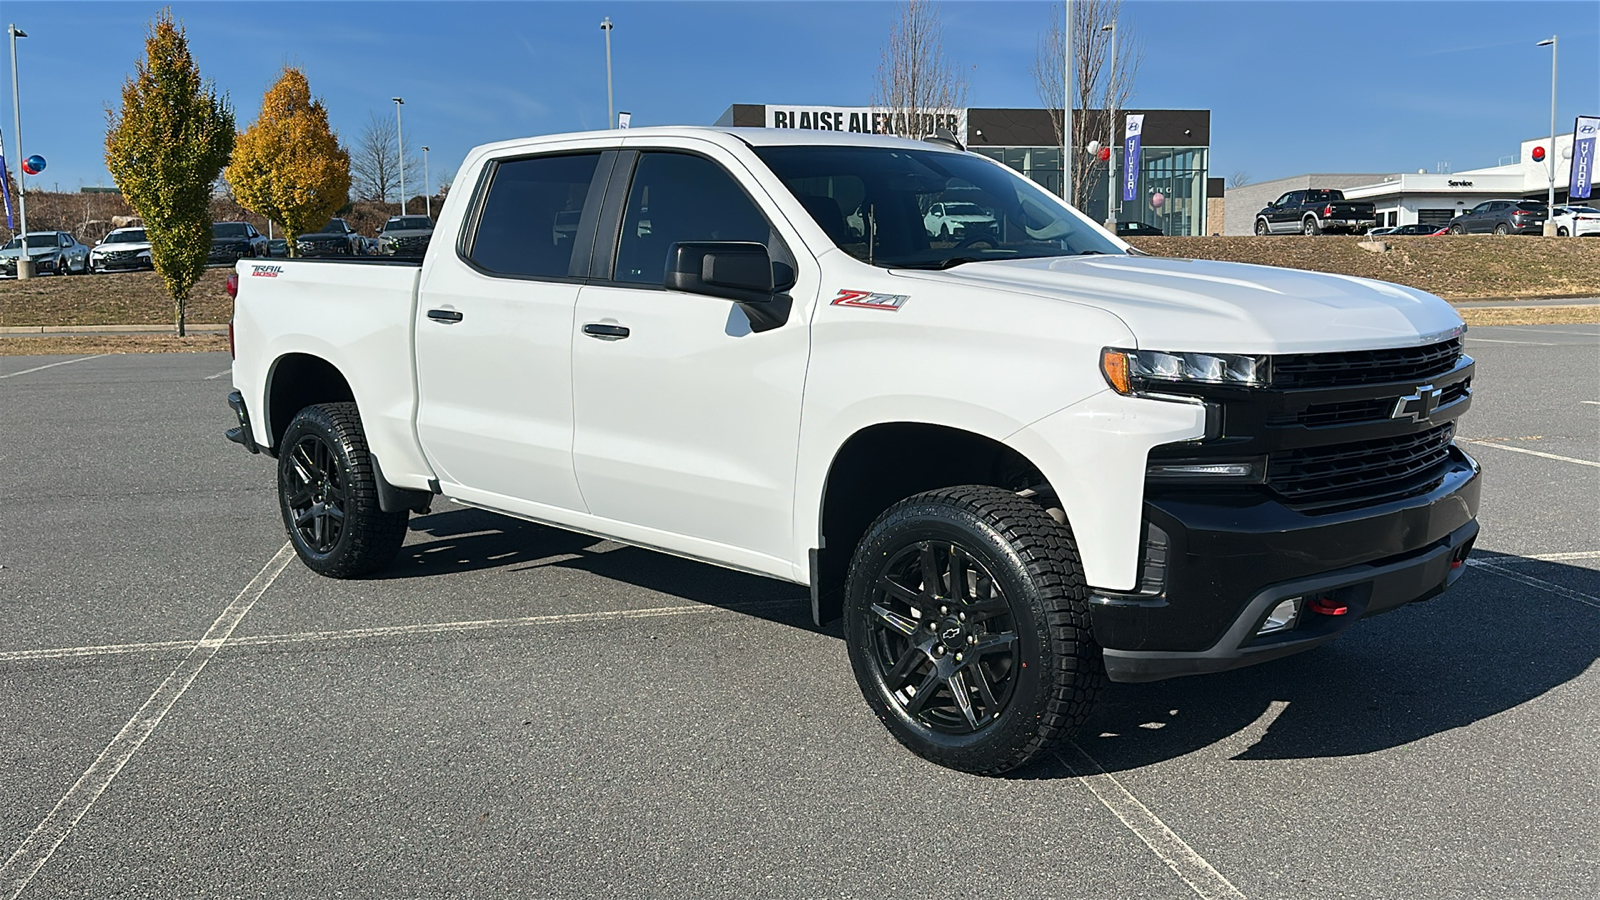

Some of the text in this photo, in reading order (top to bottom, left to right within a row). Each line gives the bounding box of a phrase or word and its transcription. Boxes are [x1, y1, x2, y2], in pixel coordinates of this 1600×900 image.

[1127, 139, 1136, 198] HYUNDAI
[1577, 141, 1589, 196] HYUNDAI
[1447, 179, 1473, 187] Service
[251, 264, 284, 273] TRAIL
[829, 288, 911, 312] Z71
